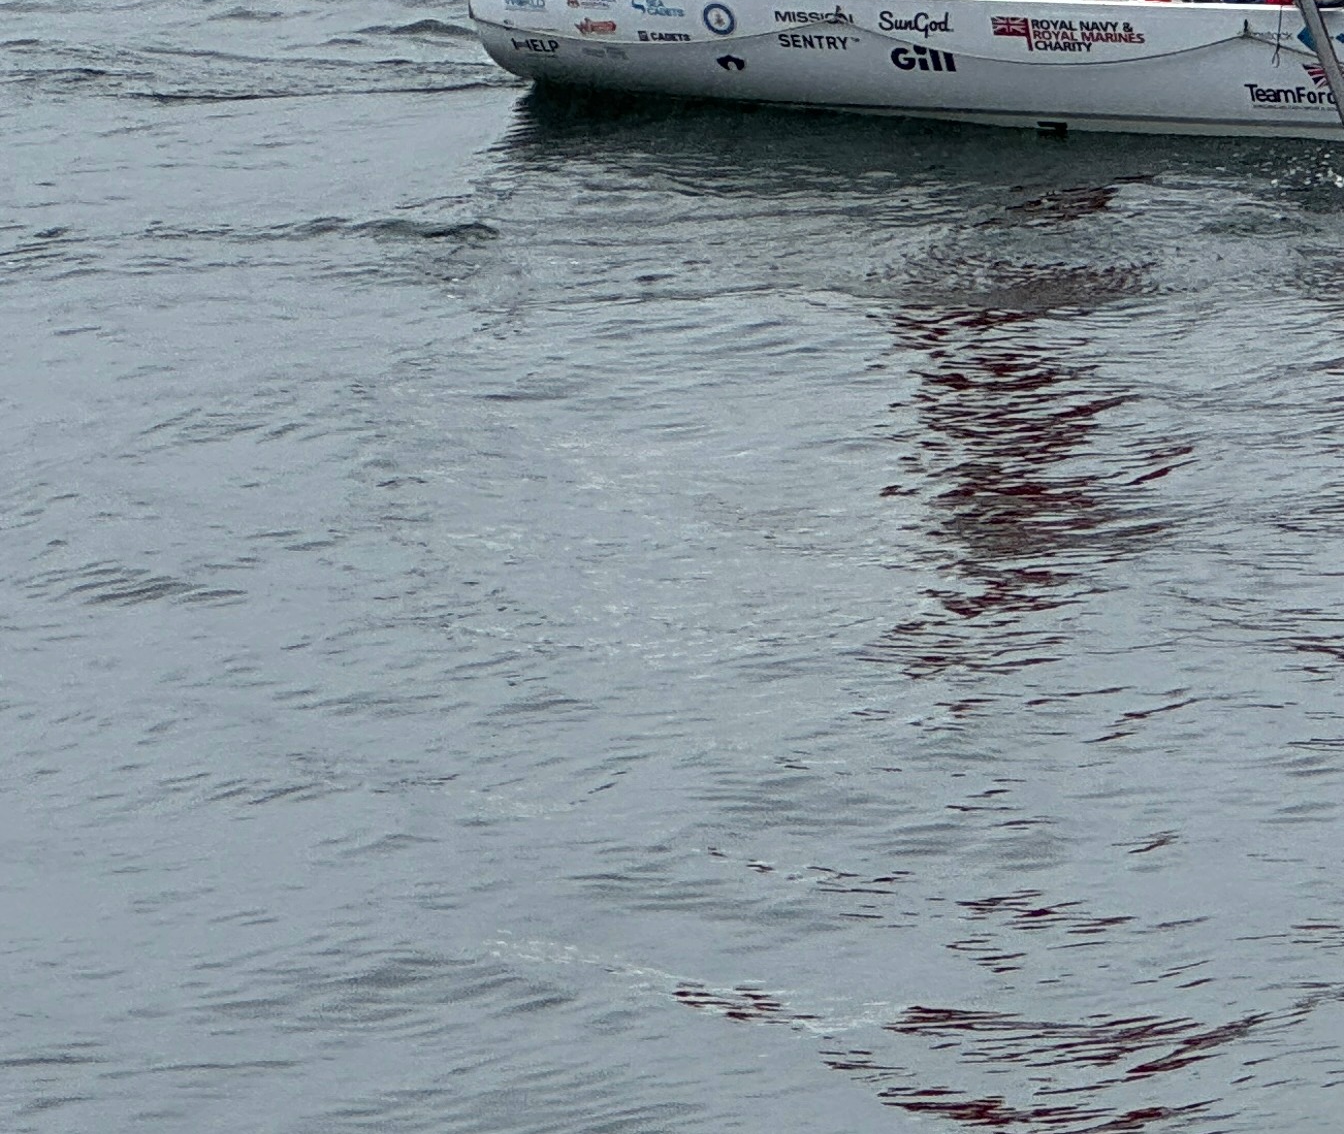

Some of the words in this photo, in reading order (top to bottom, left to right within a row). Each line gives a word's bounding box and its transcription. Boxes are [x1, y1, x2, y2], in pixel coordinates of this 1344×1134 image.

[647, 7, 686, 17] CADETS
[878, 10, 950, 39] SunGod
[1031, 19, 1078, 31] ROYAL
[1079, 20, 1118, 32] NAVY
[1122, 22, 1133, 33] &
[650, 32, 691, 41] CADETS
[778, 33, 848, 50] SENTRY
[1032, 30, 1081, 41] ROYAL
[1081, 32, 1145, 44] MARINES
[1034, 40, 1093, 52] CHARITY
[890, 44, 957, 72] Gill
